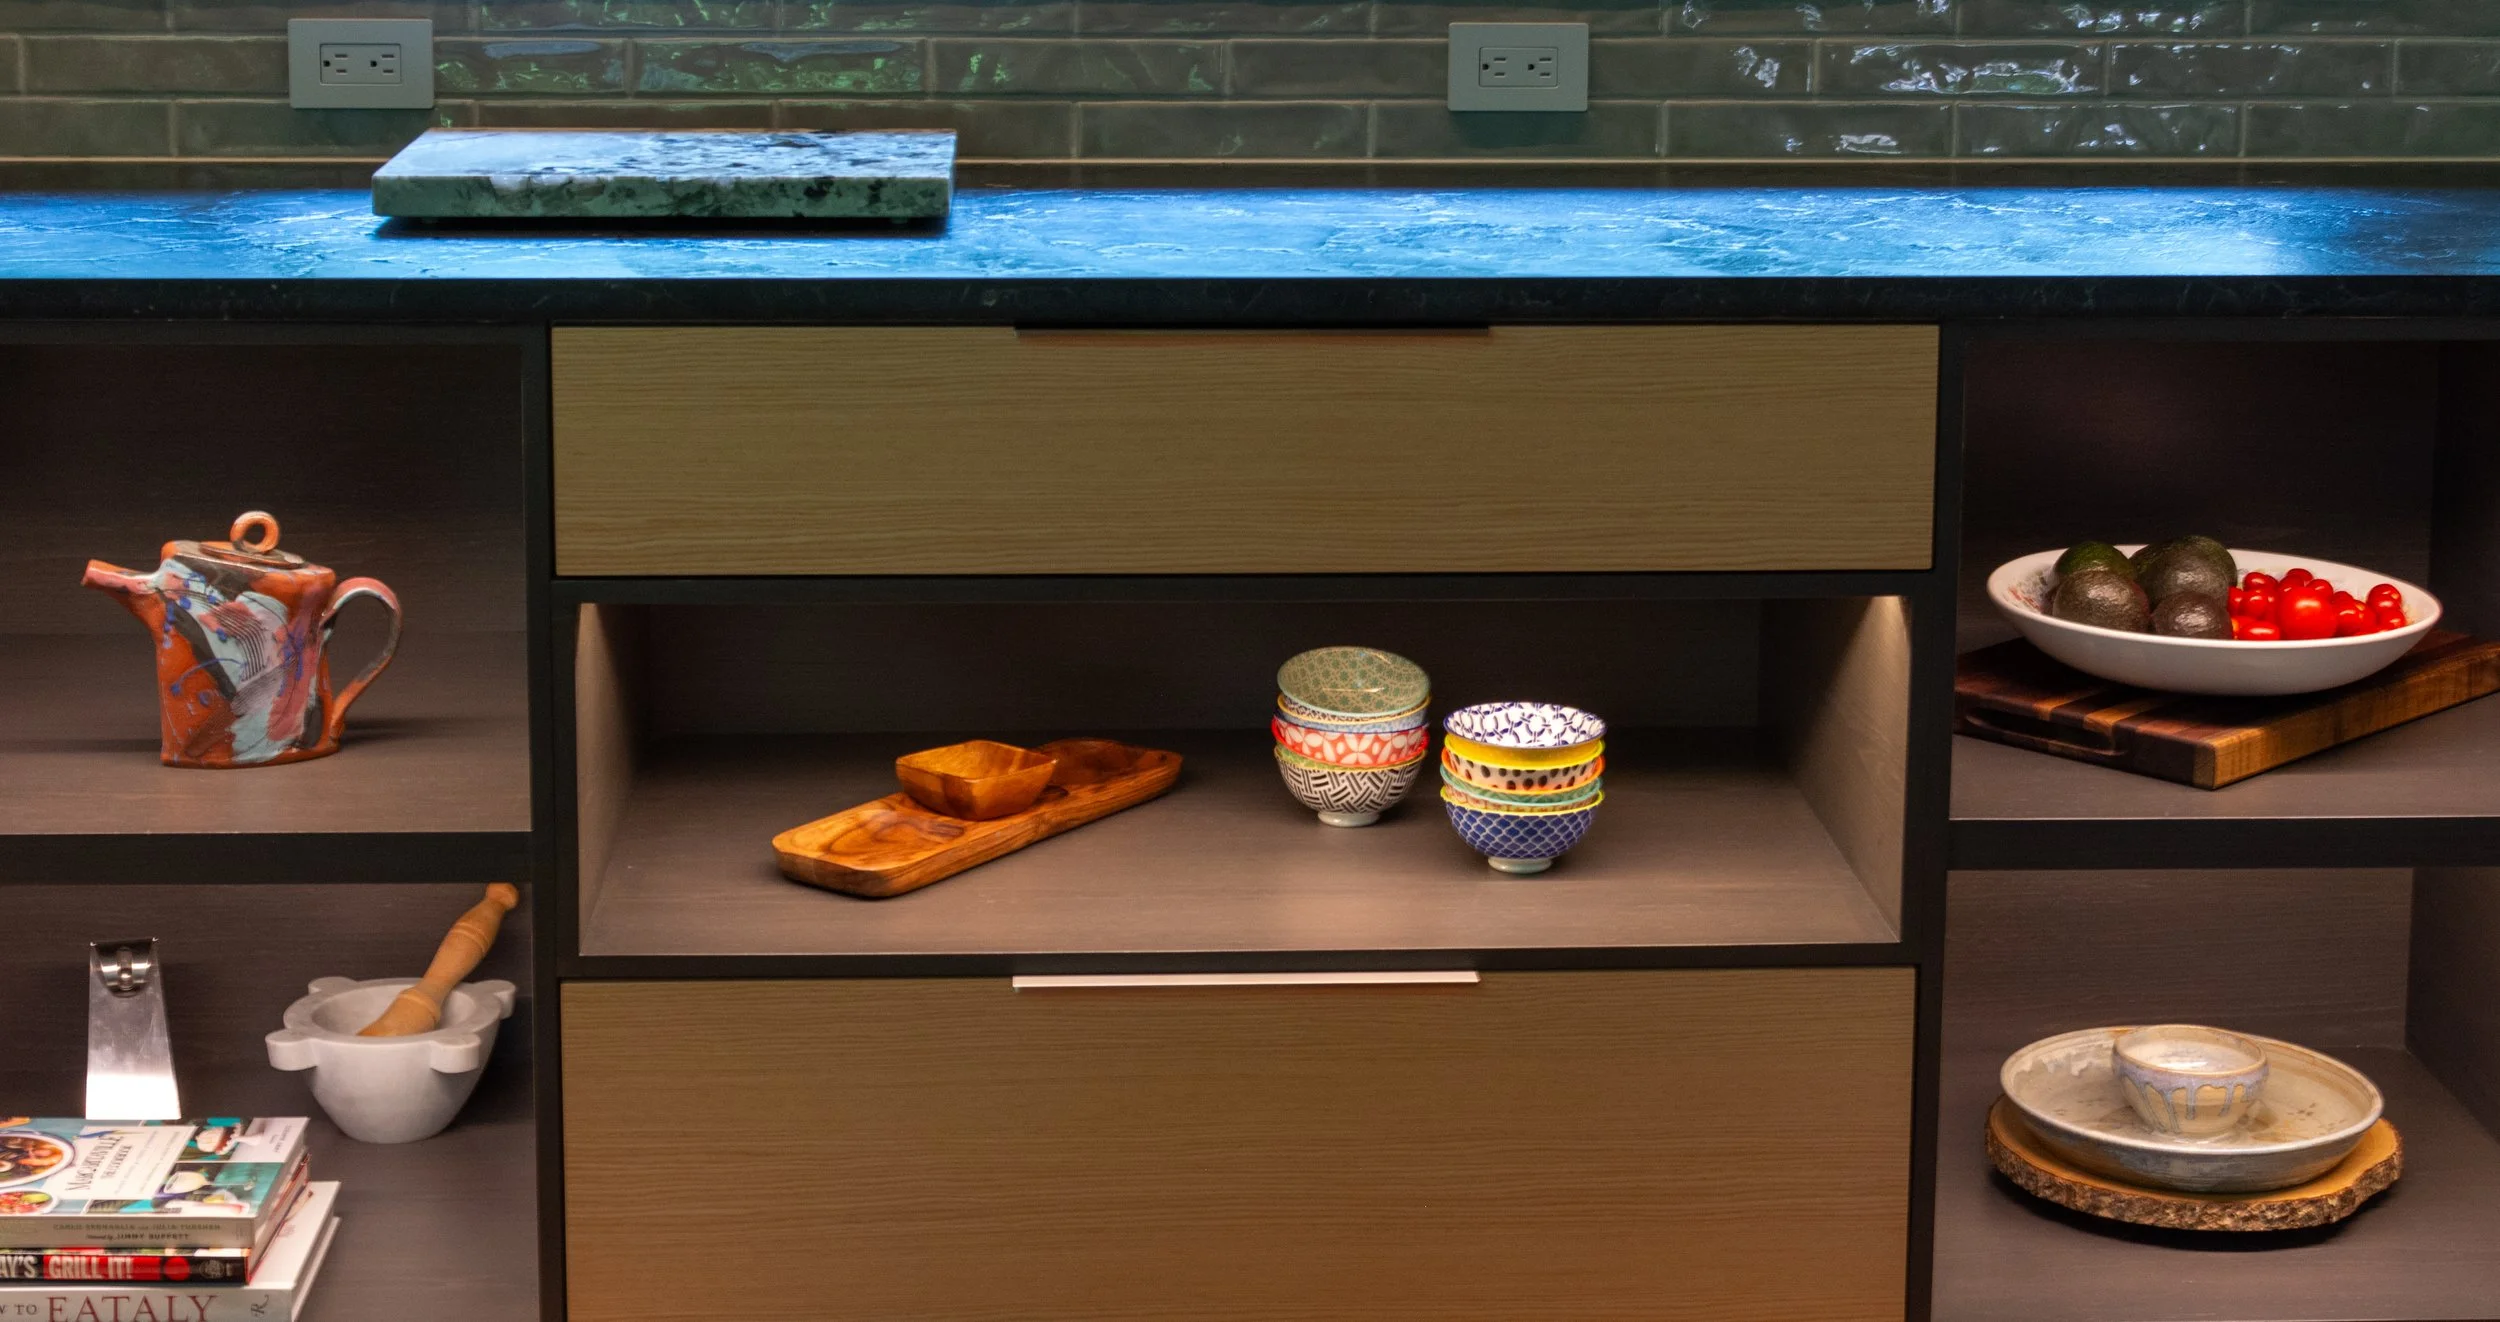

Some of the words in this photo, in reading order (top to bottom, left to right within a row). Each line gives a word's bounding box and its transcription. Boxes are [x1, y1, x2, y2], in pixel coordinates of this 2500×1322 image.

[49, 1255, 106, 1280] GRILL
[107, 1255, 134, 1280] IT!
[13, 1303, 38, 1316] TO
[46, 1295, 218, 1322] EATALY
